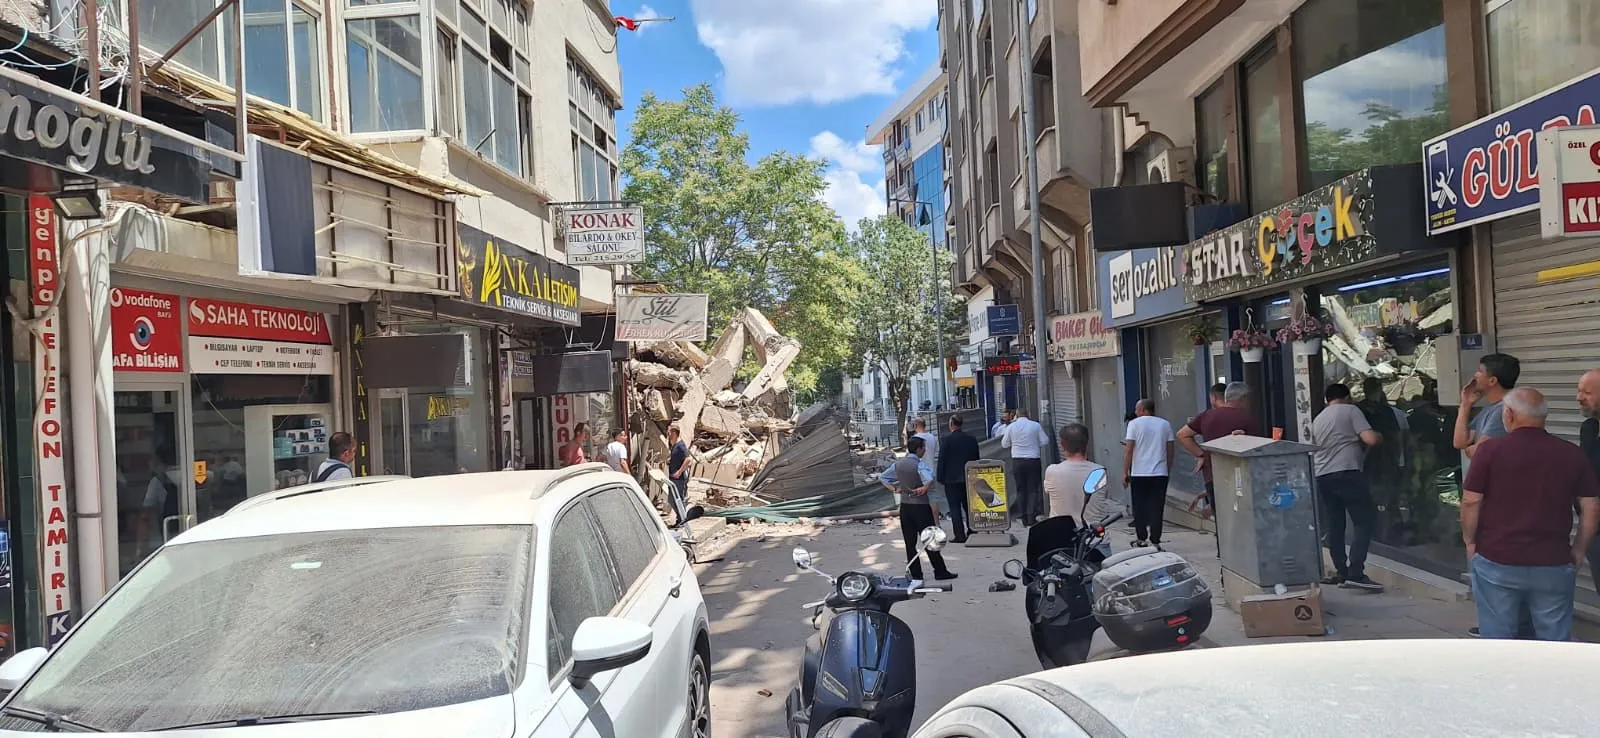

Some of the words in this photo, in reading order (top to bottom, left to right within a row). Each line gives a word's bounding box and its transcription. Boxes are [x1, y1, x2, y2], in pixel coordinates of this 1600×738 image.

[570, 212, 635, 229] KONAK
[1568, 197, 1600, 224] KI
[607, 234, 612, 242] &
[615, 231, 637, 242] OKEY
[586, 243, 620, 252] SALONU
[1191, 231, 1249, 286] STAR
[480, 240, 542, 306] ANKA
[544, 273, 577, 308] İLETİŞİM
[1112, 269, 1130, 304] ser
[125, 294, 171, 310] vodafone
[502, 294, 526, 312] TEKNİK
[527, 301, 547, 316] SERVİS
[547, 306, 552, 318] &
[642, 296, 680, 316] Stil
[207, 304, 248, 327] SAHA
[136, 351, 179, 368] BİLİŞİM
